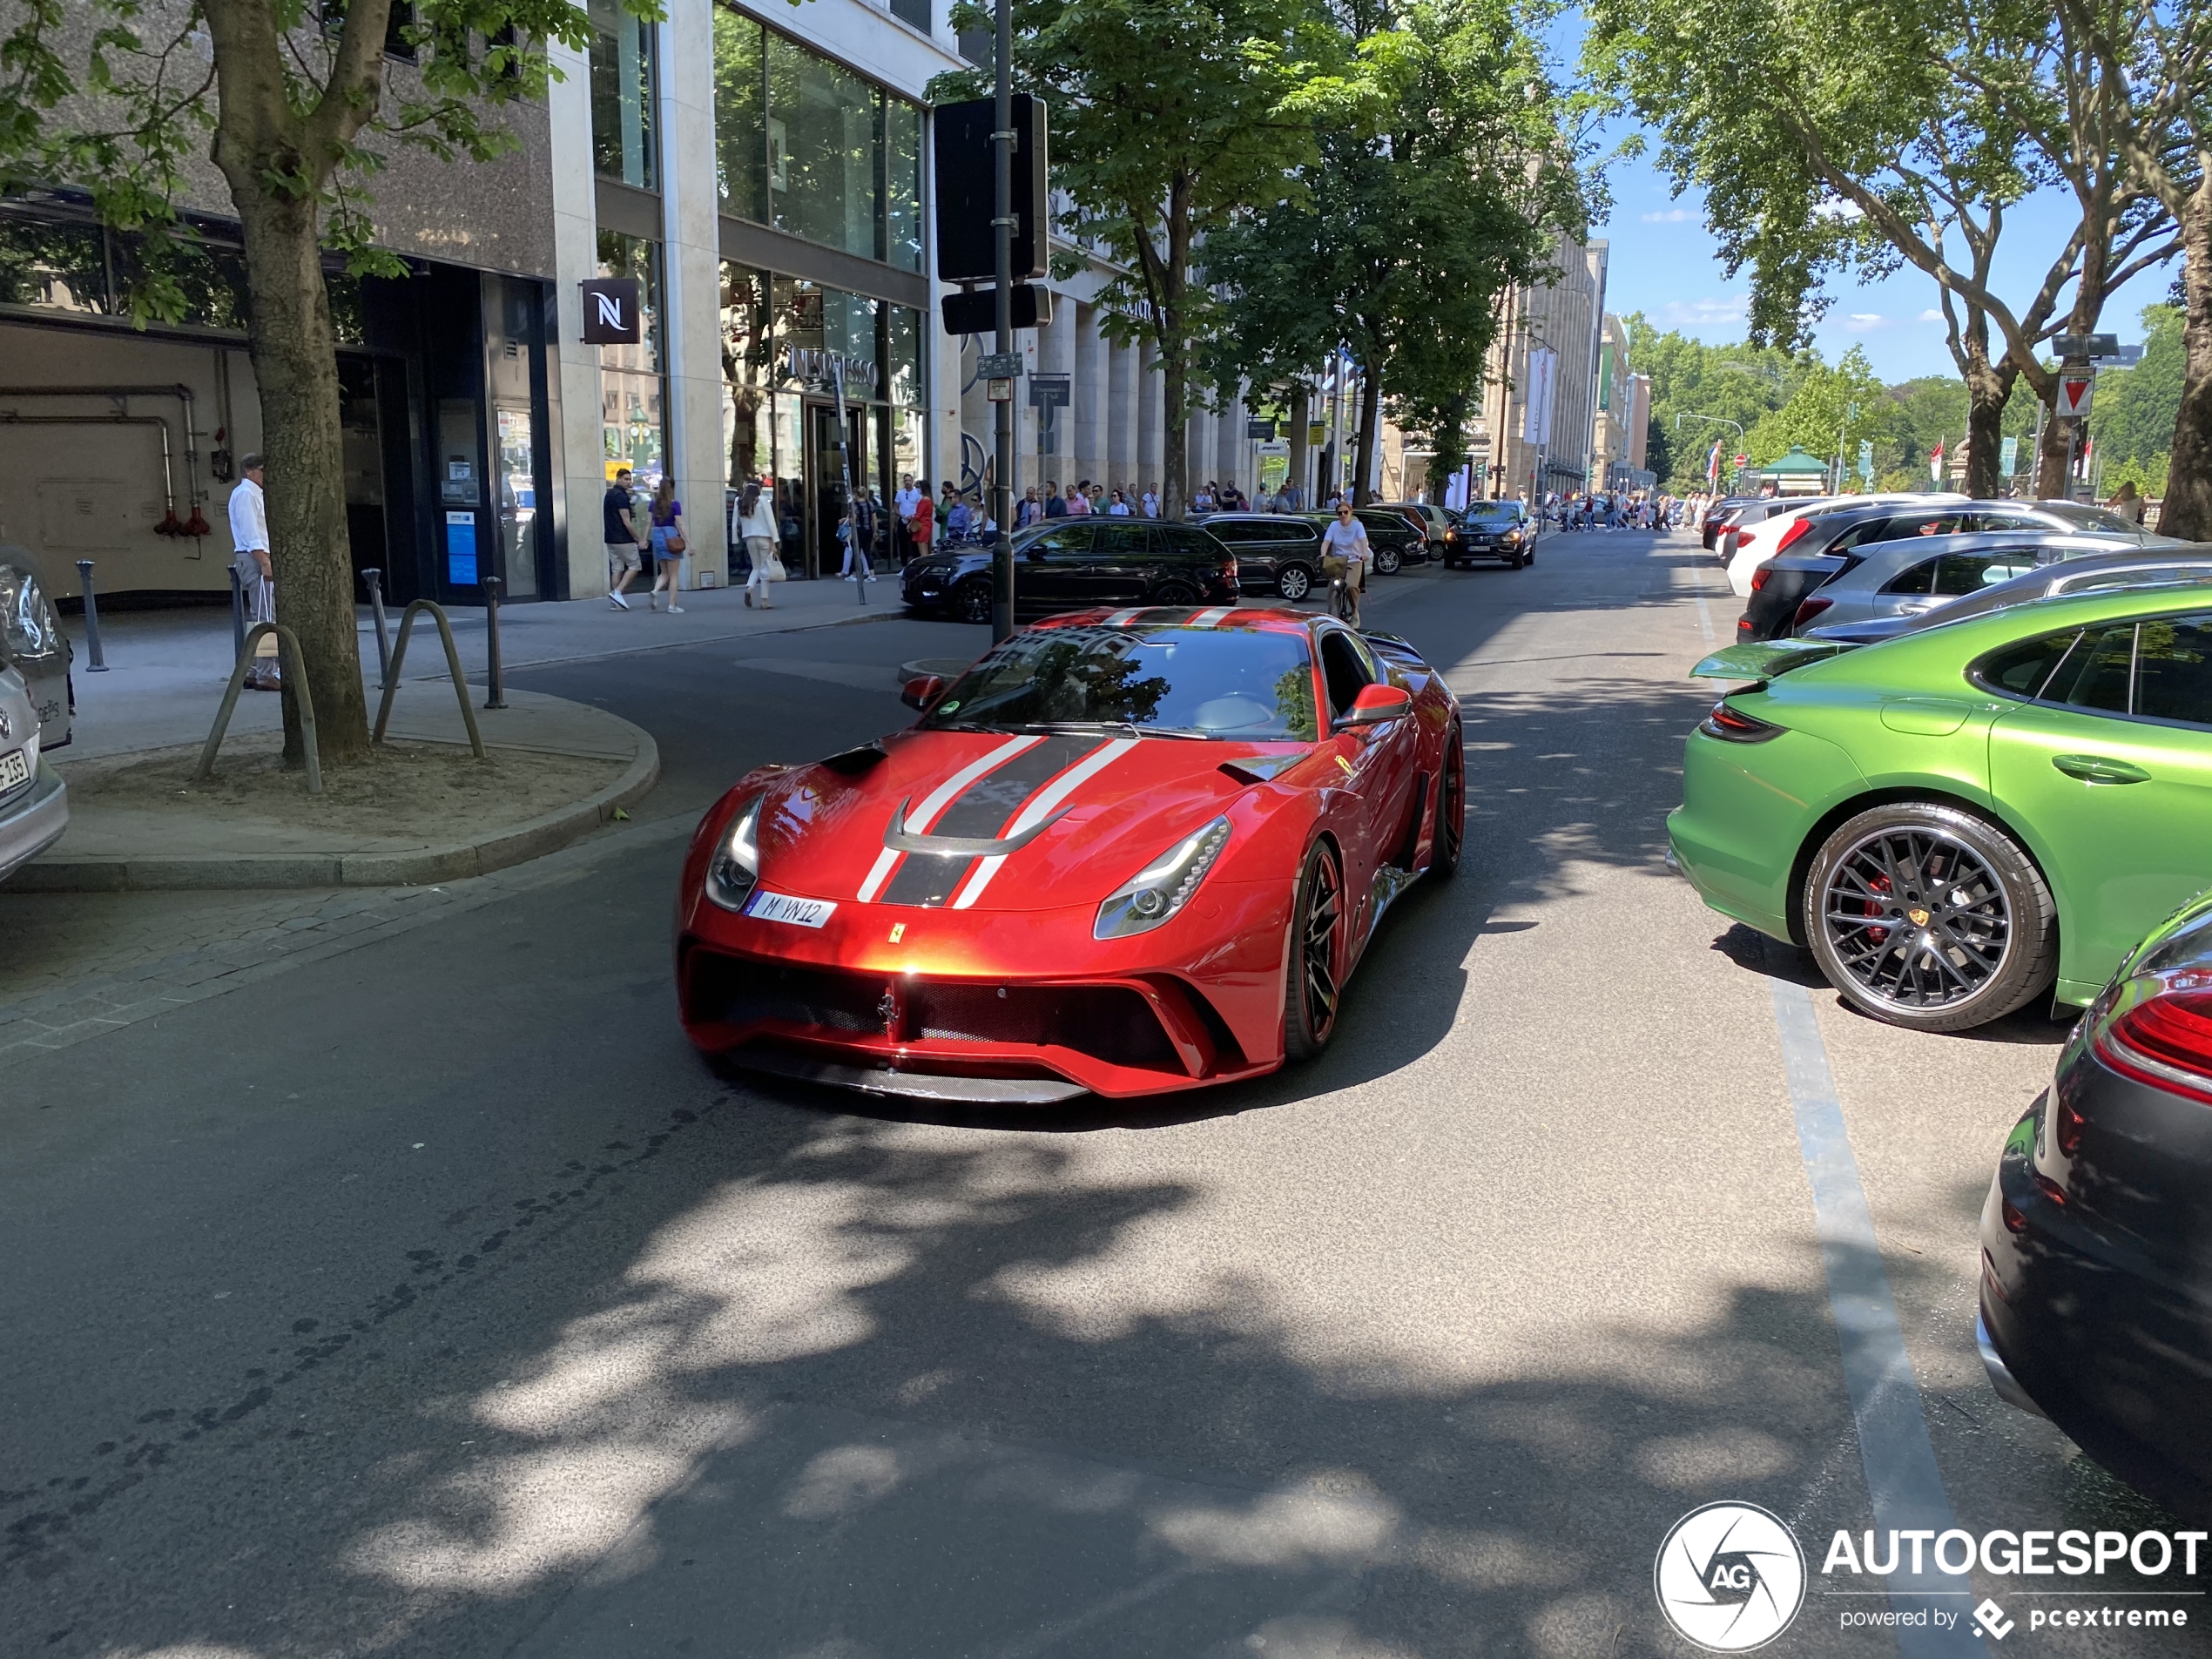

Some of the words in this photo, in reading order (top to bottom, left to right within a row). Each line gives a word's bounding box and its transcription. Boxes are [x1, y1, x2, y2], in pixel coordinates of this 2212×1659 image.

[590, 292, 631, 331] N
[4, 755, 24, 783] 135
[762, 896, 782, 916] M
